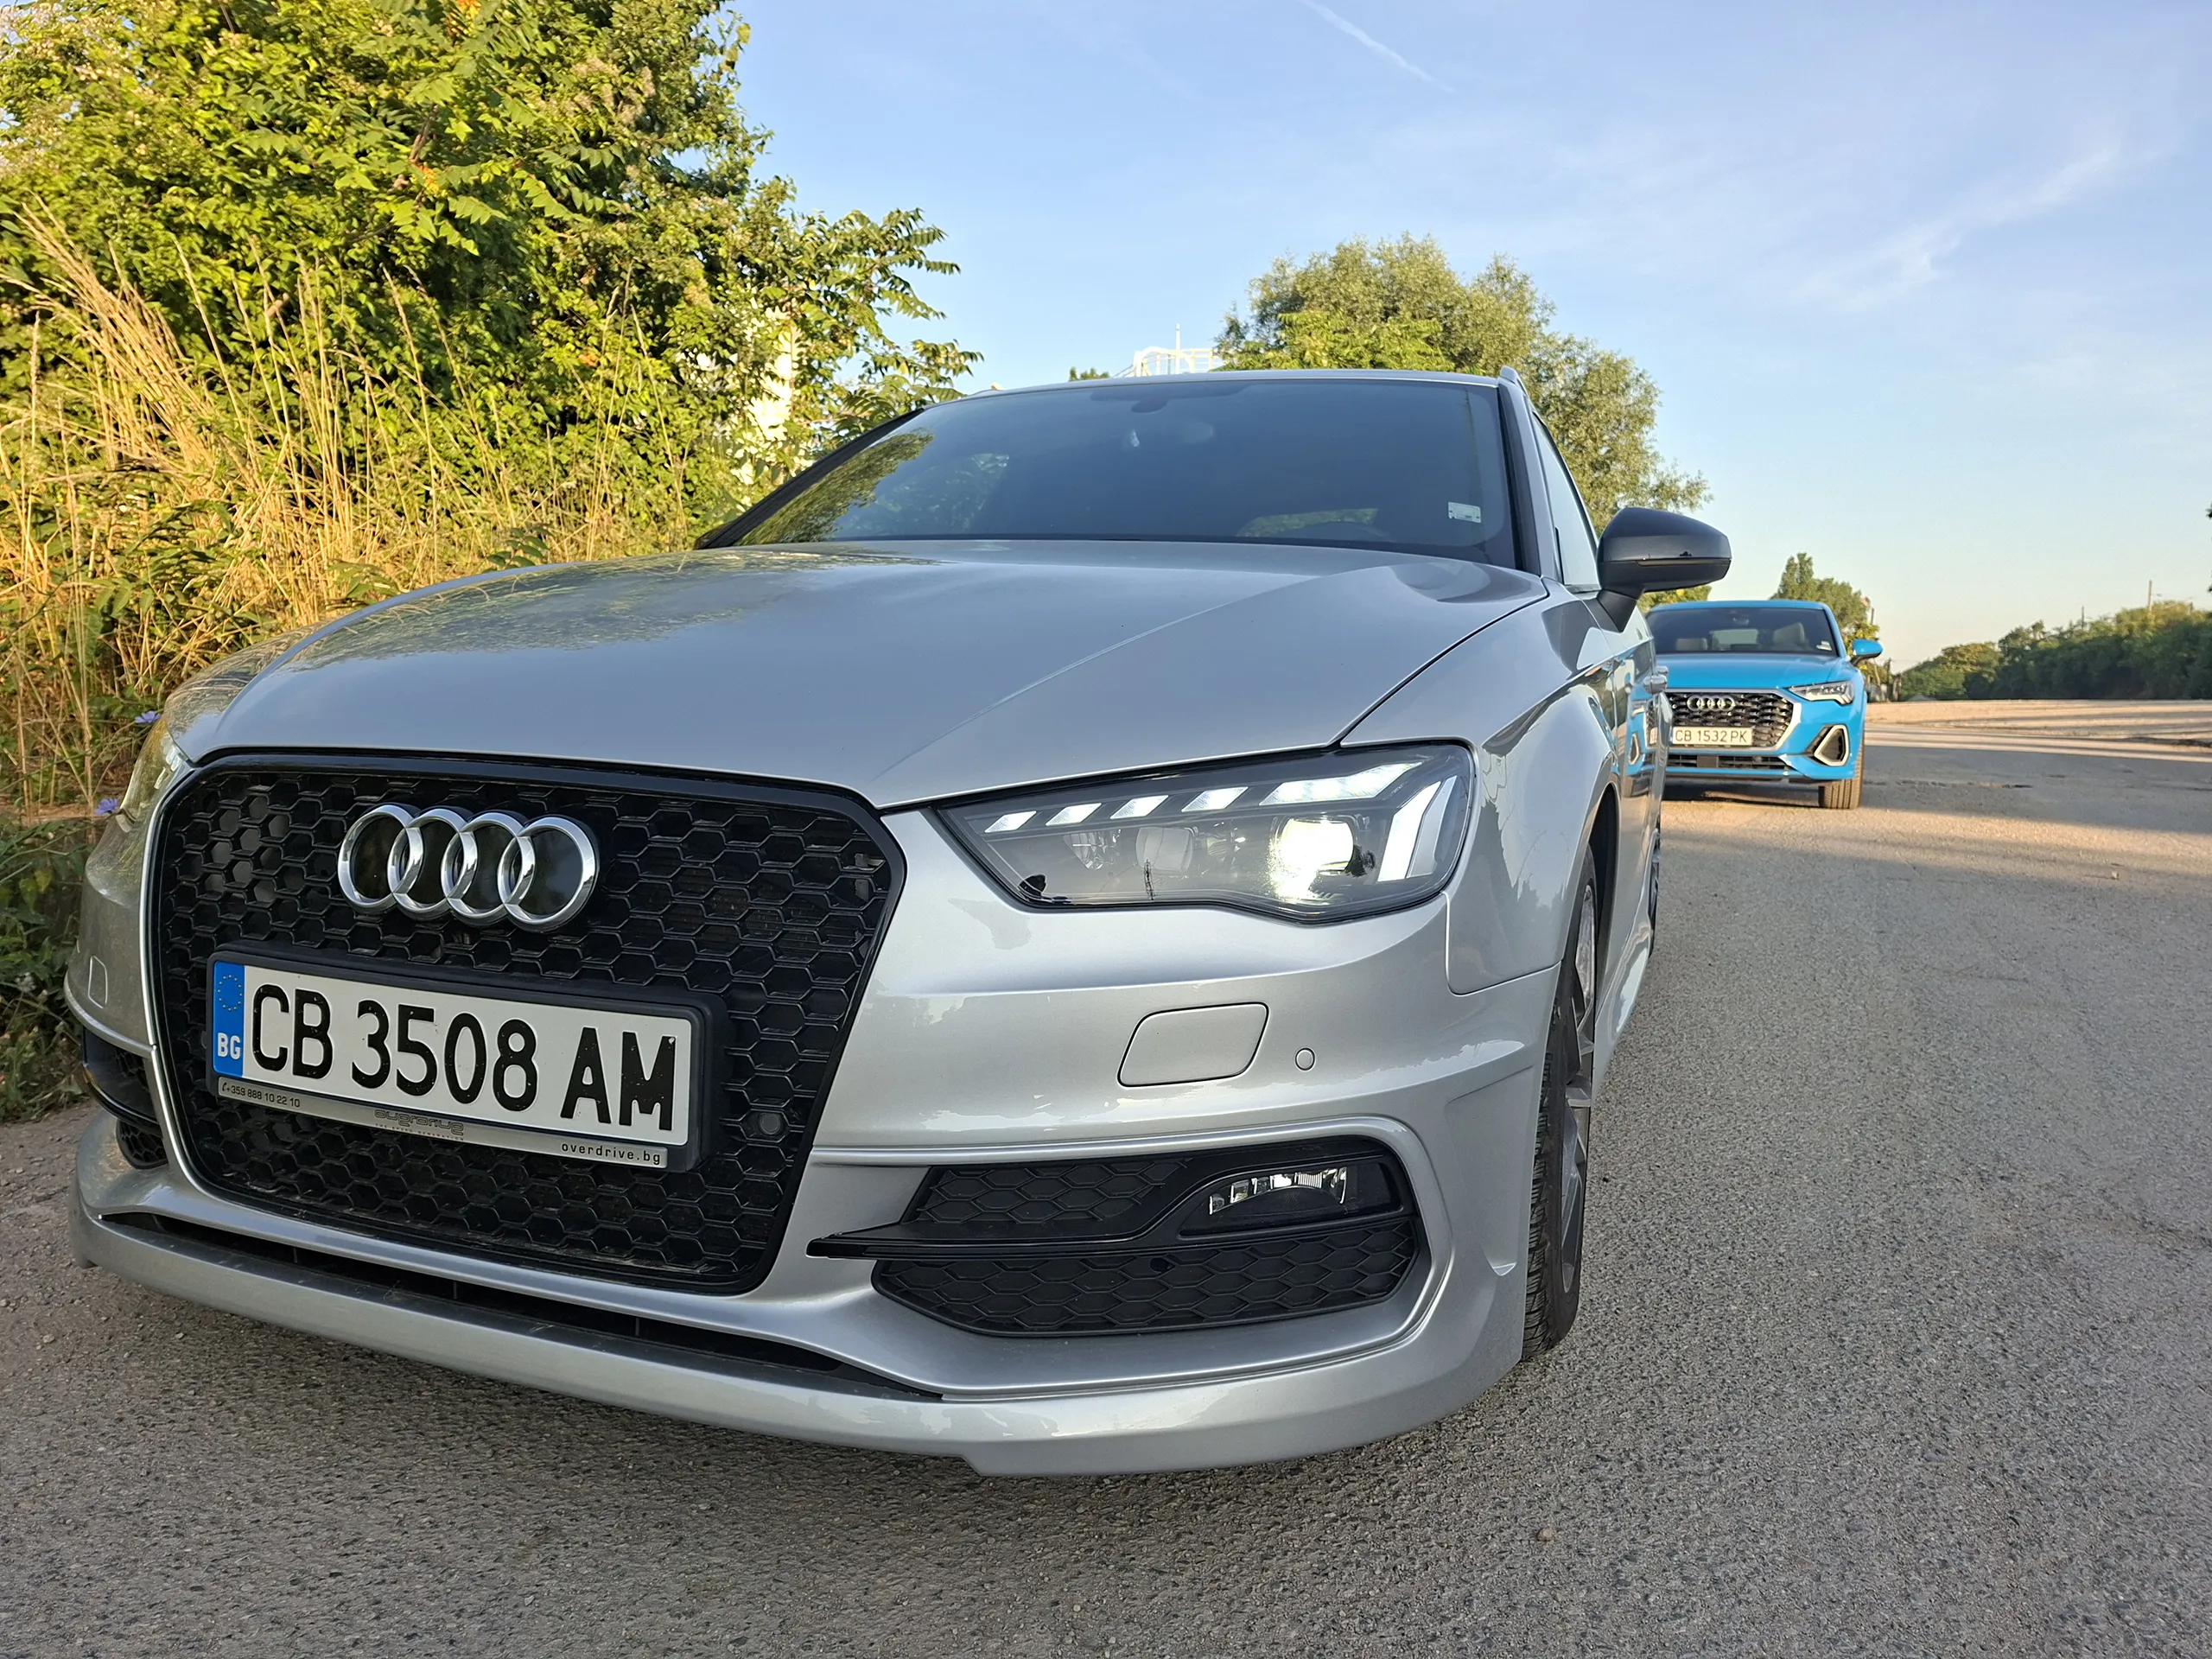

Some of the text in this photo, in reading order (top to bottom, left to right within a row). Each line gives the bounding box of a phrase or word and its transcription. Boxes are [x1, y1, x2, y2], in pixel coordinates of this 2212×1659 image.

[1675, 729, 1747, 743] CB 1532 PK
[217, 1032, 241, 1060] BG
[251, 983, 677, 1131] CB 3508 AM
[247, 1089, 263, 1100] 888
[264, 1092, 275, 1103] 10
[276, 1095, 288, 1105] 22
[289, 1098, 301, 1108] 10
[562, 1143, 660, 1166] overdrive.bg
